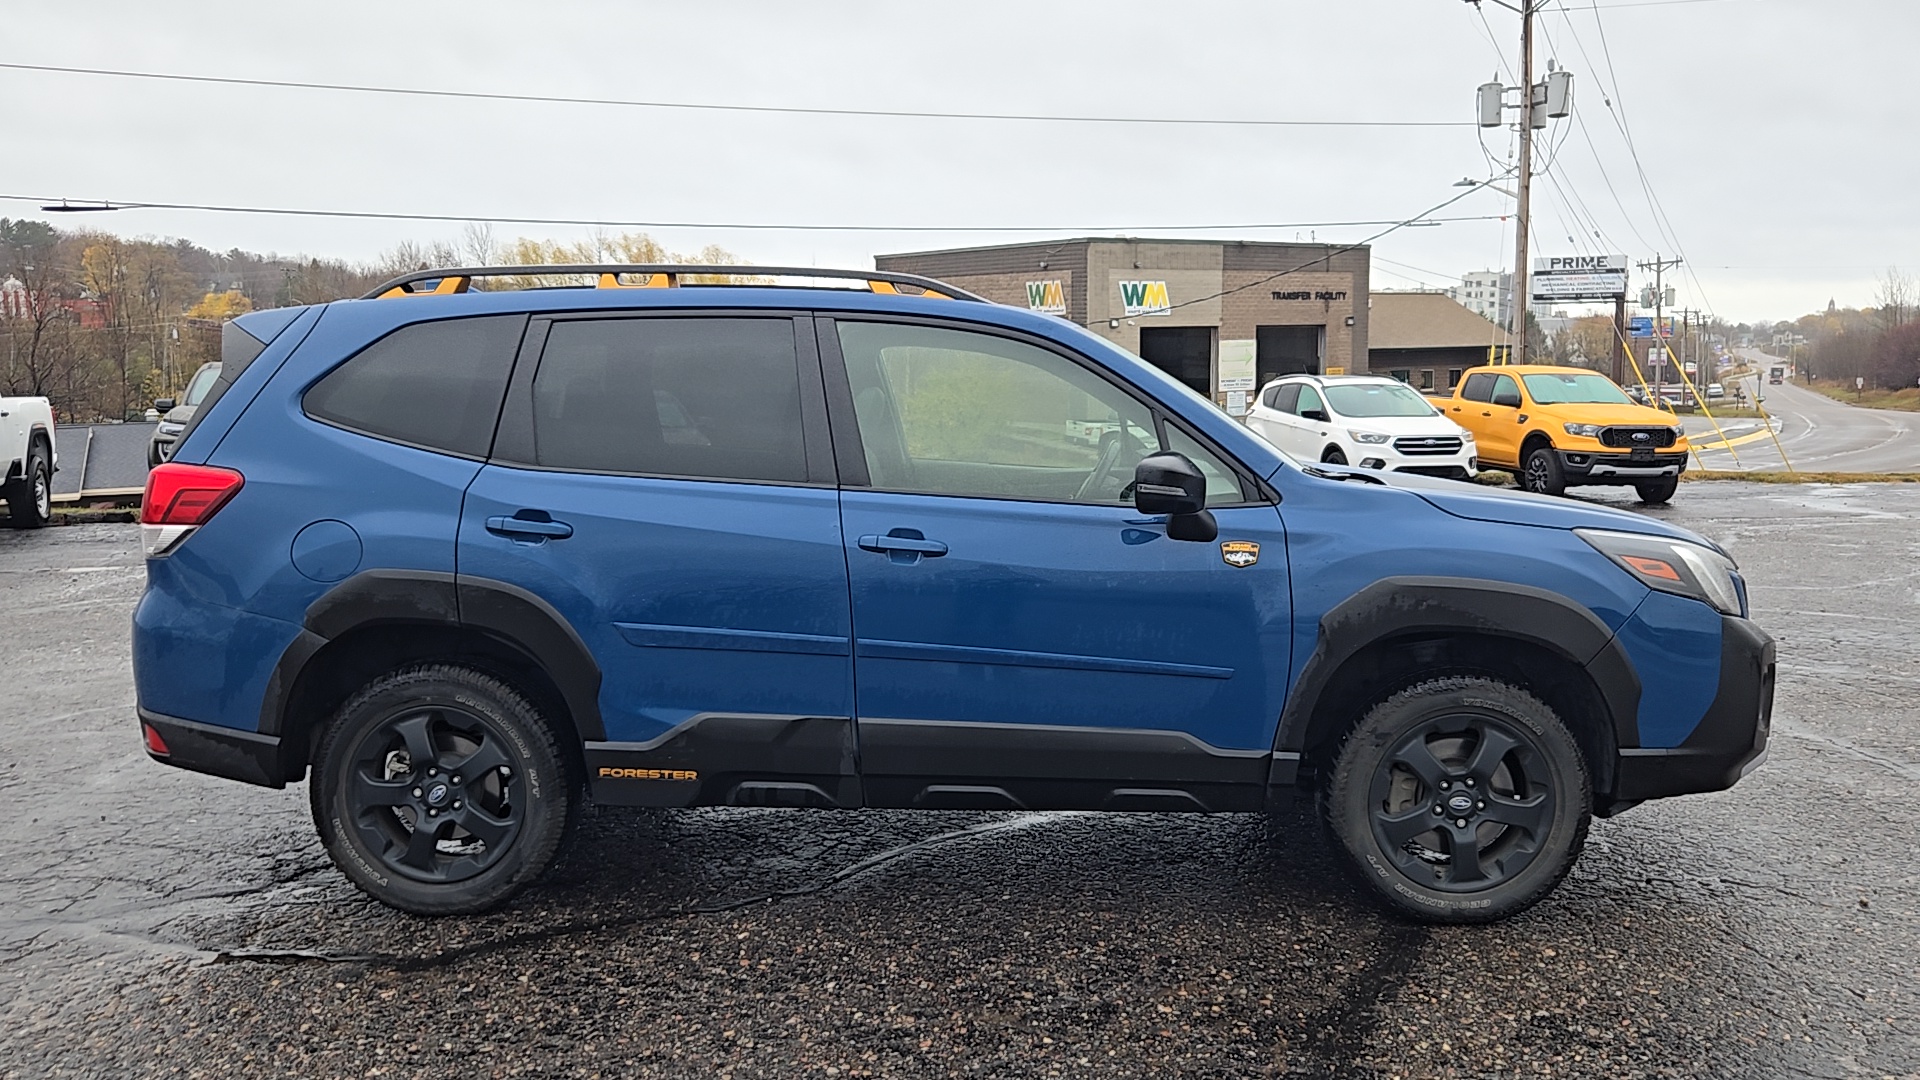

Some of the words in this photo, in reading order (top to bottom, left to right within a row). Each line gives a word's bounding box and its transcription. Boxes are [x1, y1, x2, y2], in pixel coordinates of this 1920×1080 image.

[1550, 256, 1608, 269] PRIME
[1028, 283, 1063, 306] WM
[1122, 283, 1168, 306] WM
[1271, 291, 1311, 300] TRANSFER
[1315, 291, 1347, 300] FACILITY
[1463, 698, 1544, 735] YOKOHAMA
[598, 767, 698, 780] FORESTER
[332, 818, 389, 887] YOKOHAMA
